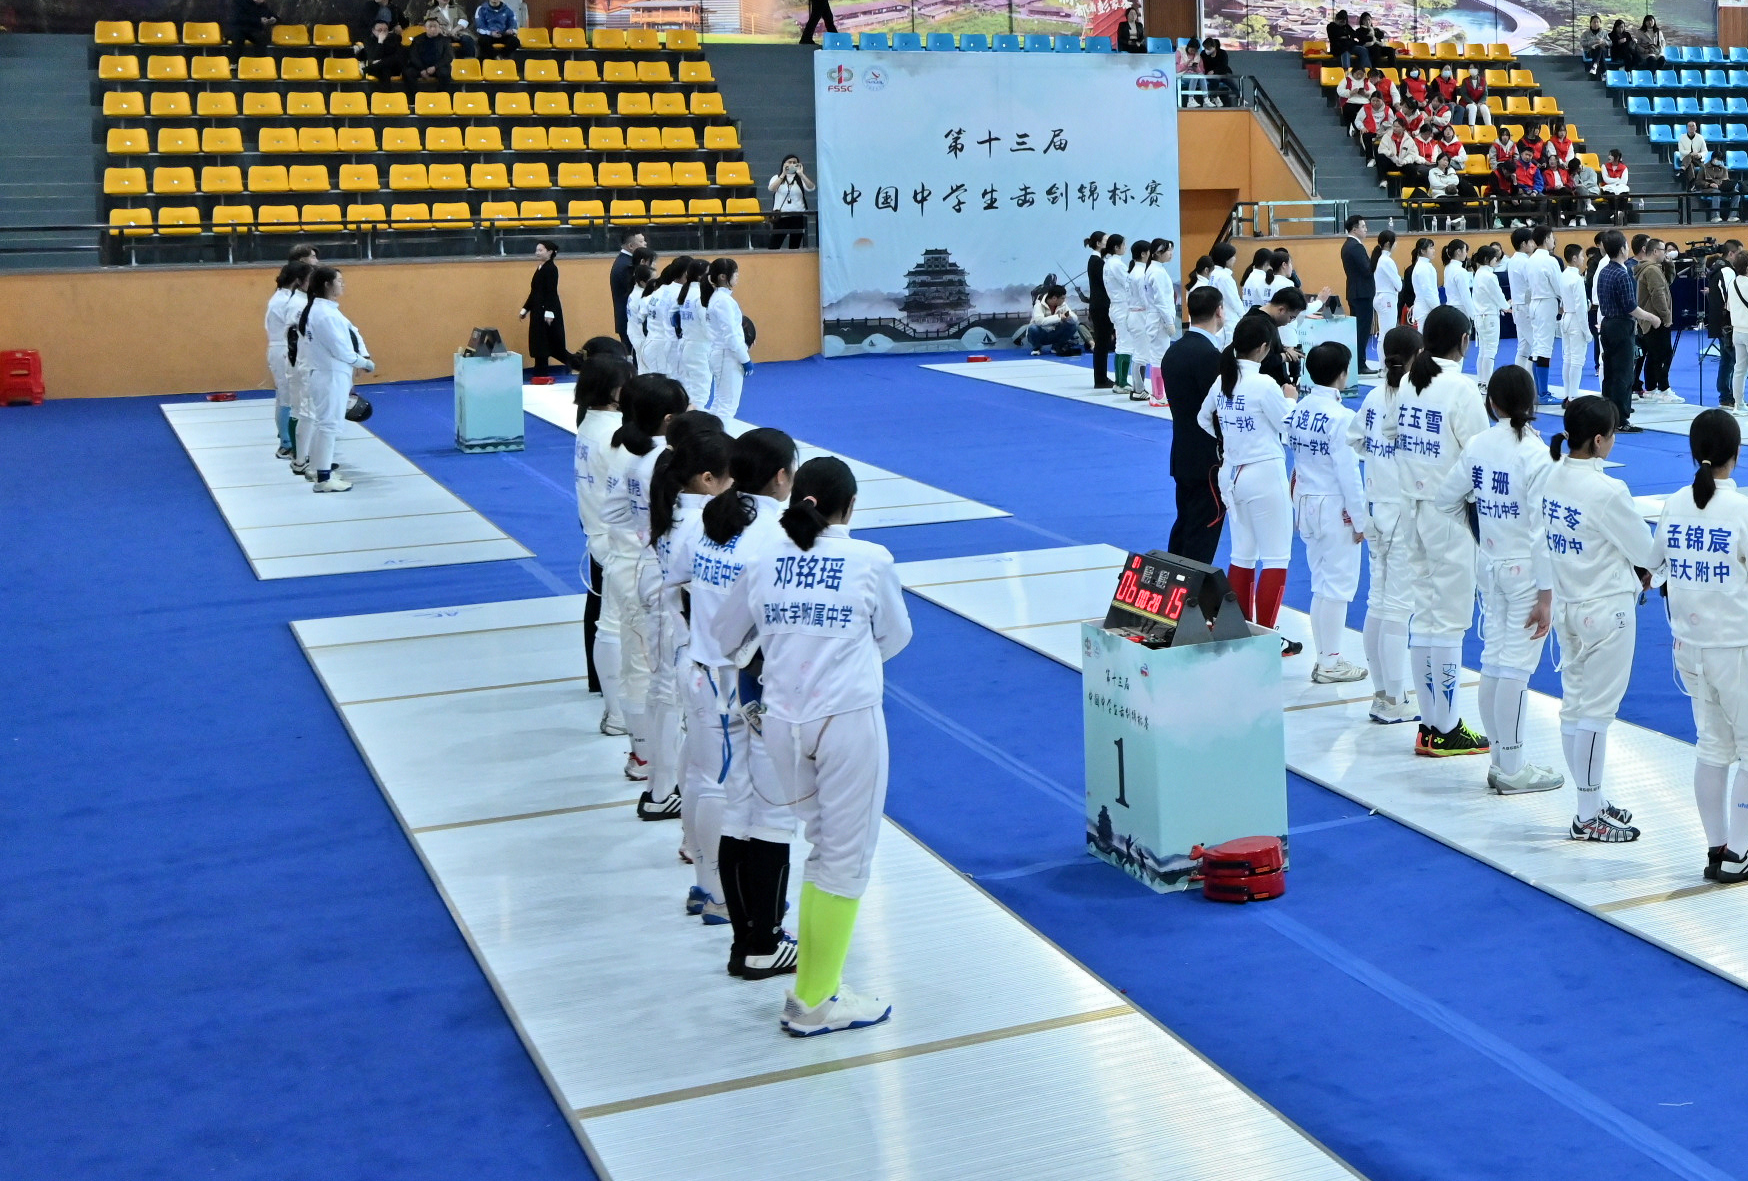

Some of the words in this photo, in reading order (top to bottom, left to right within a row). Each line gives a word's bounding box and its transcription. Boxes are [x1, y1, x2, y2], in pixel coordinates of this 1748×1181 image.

[828, 85, 853, 93] FSSC
[944, 128, 1069, 159] 第十三届
[842, 180, 1164, 218] 中国中学生击剑锦标赛
[1472, 465, 1509, 495] 姜珊
[1667, 524, 1732, 554] 孟锦宸
[773, 555, 845, 592] 邓铭瑶
[1165, 587, 1187, 619] 15
[1114, 738, 1129, 808] 1
